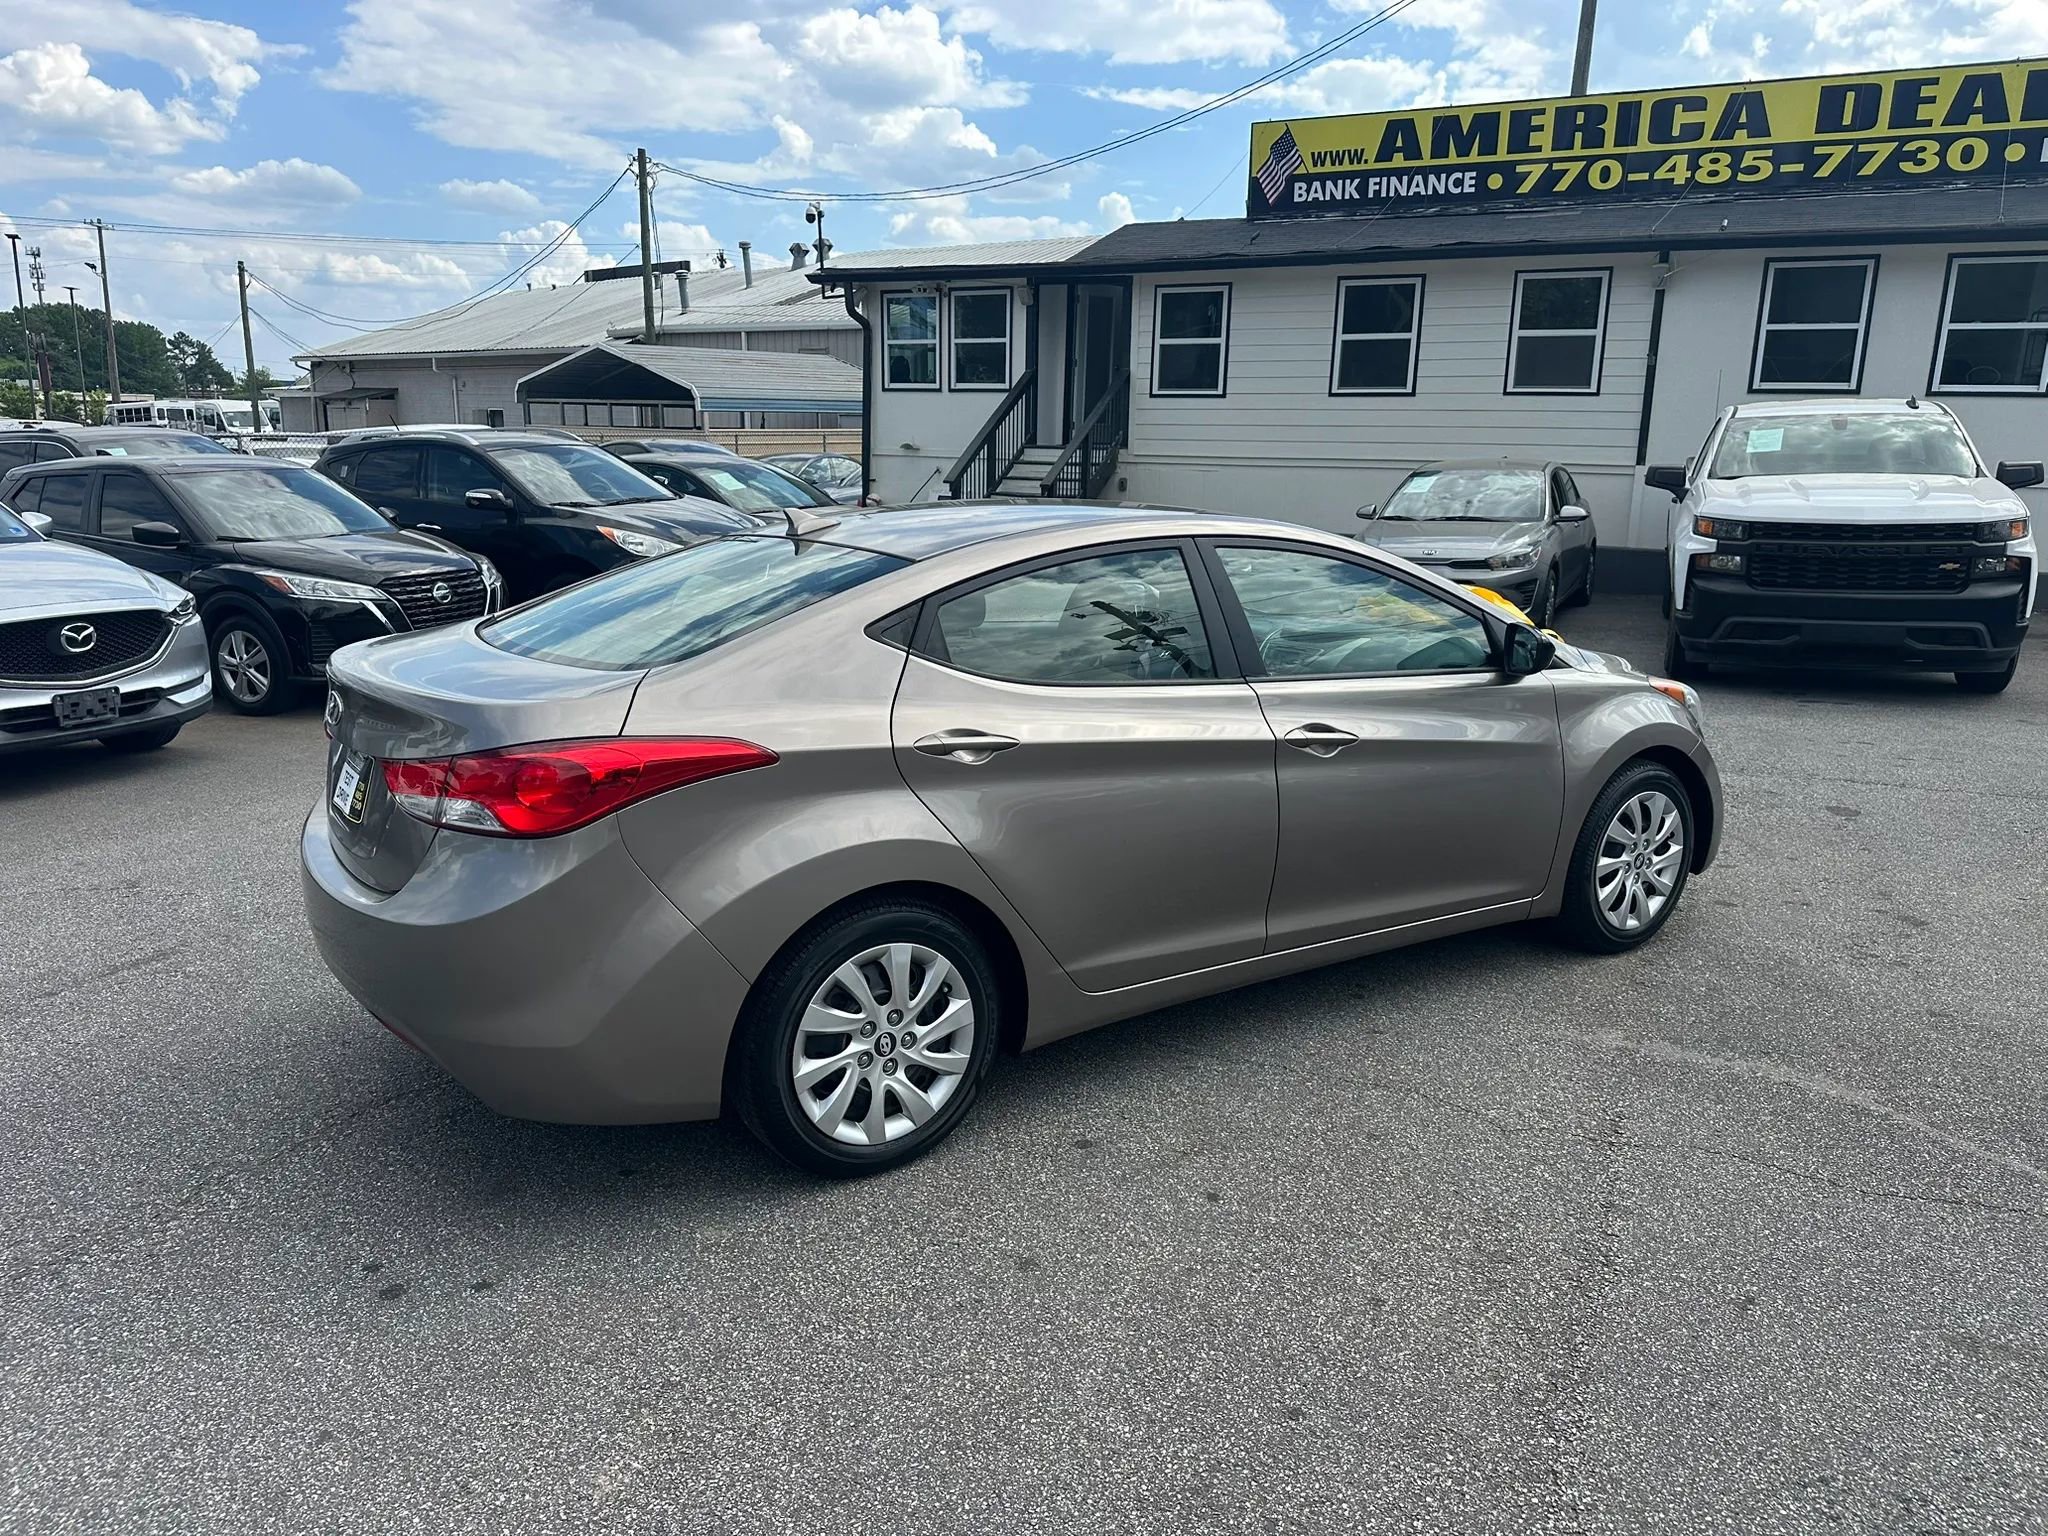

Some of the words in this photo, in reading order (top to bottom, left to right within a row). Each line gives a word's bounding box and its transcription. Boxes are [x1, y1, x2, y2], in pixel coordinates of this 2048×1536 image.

[1373, 90, 1772, 164] AMERICA
[1293, 177, 1361, 203] BANK
[1367, 171, 1478, 199] FINANCE
[1515, 137, 1990, 194] 770-485-7730
